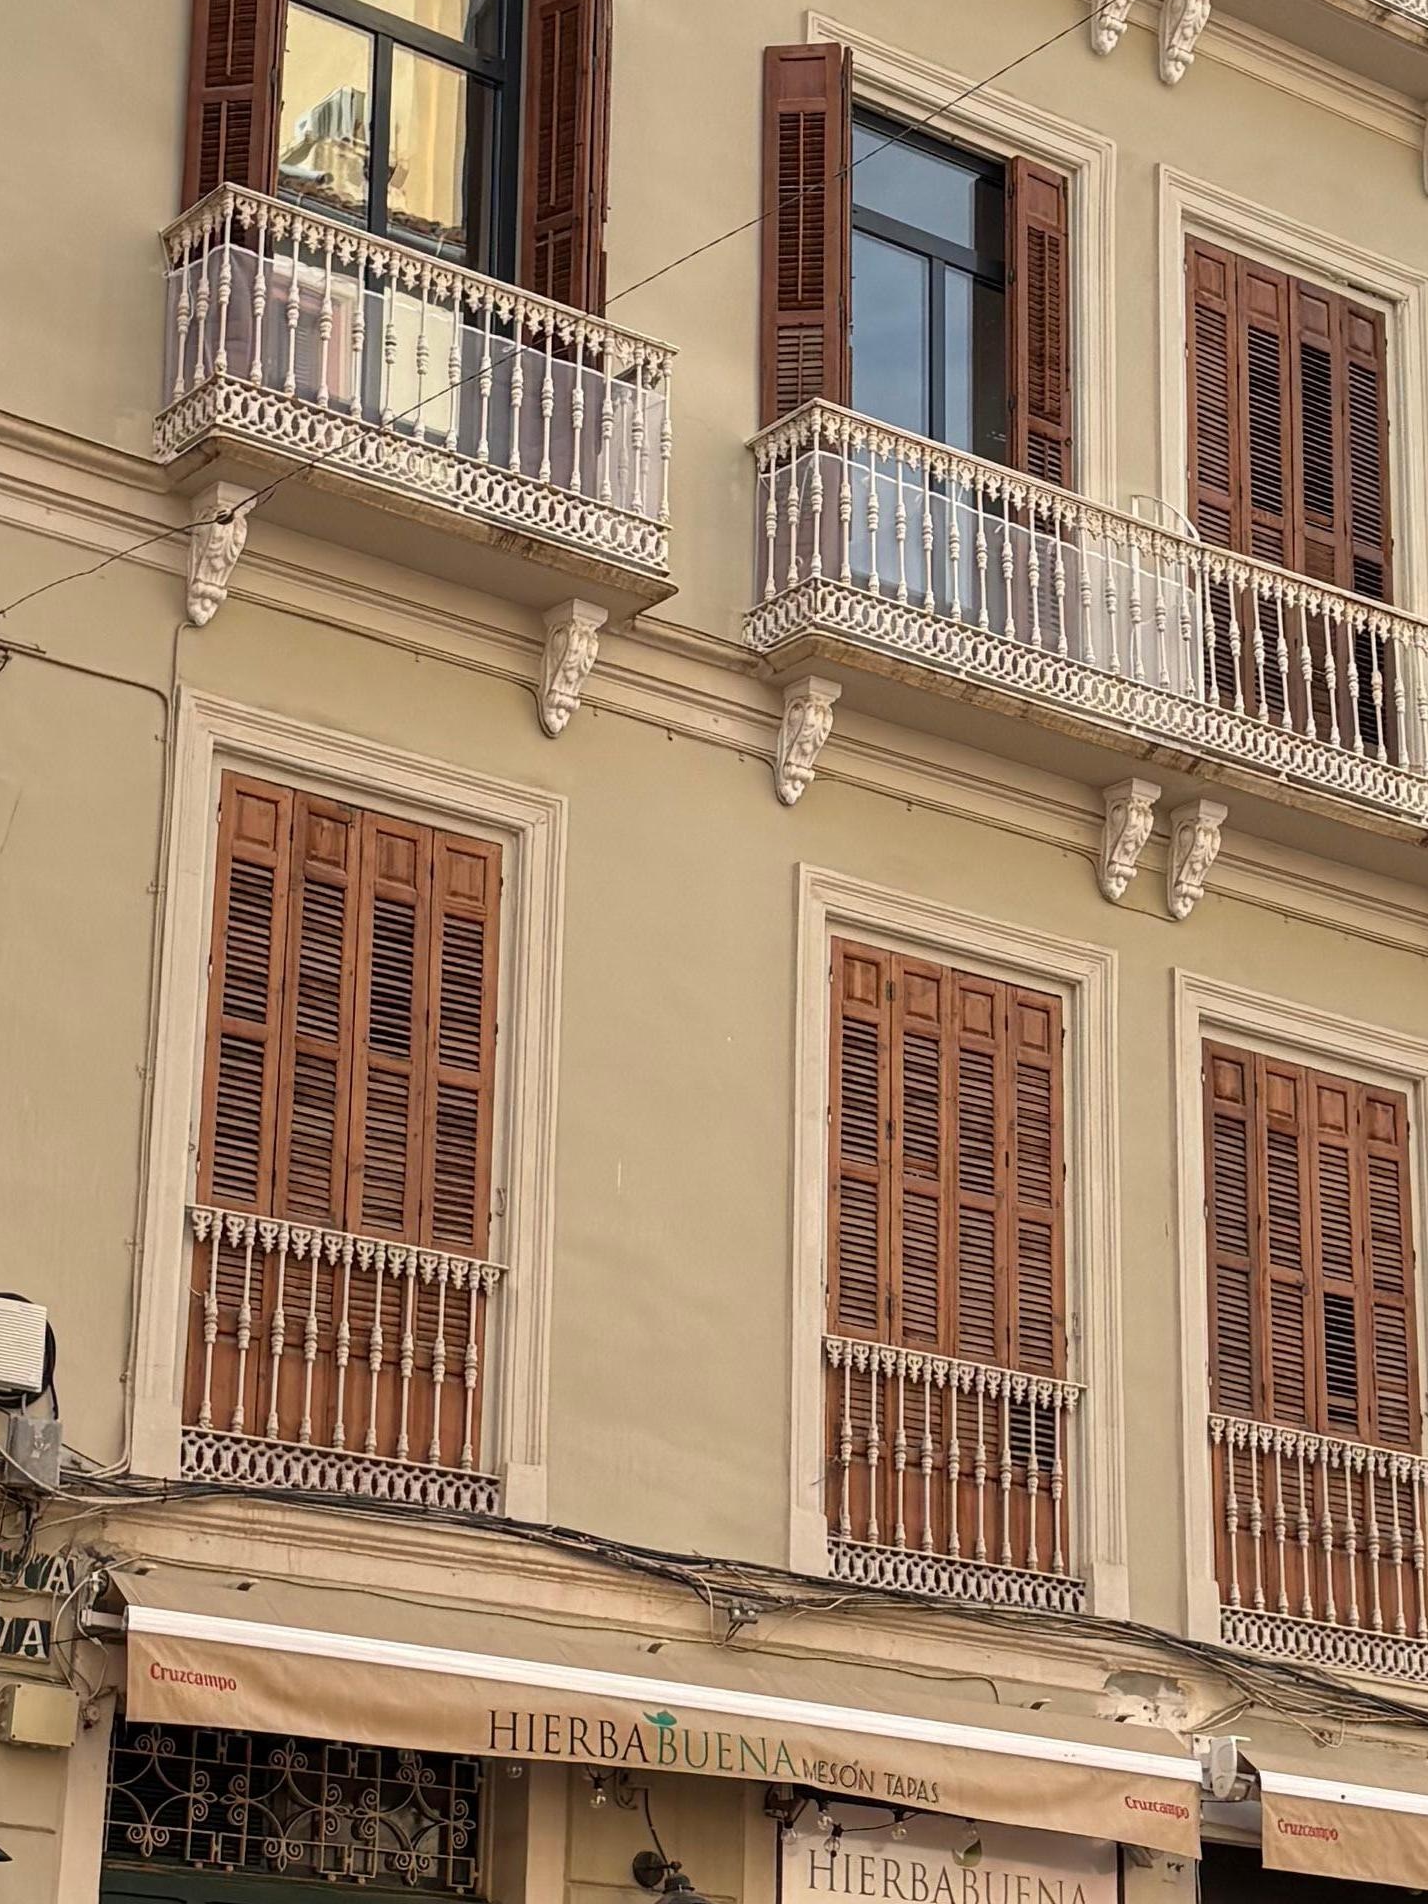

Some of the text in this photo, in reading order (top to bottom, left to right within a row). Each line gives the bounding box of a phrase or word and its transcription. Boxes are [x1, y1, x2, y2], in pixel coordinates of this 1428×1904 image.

[150, 1662, 237, 1691] Cruzcampo
[489, 1709, 939, 1803] HIERBABUENA MESÓN TAPAS
[1124, 1795, 1190, 1820] Cruzcampo
